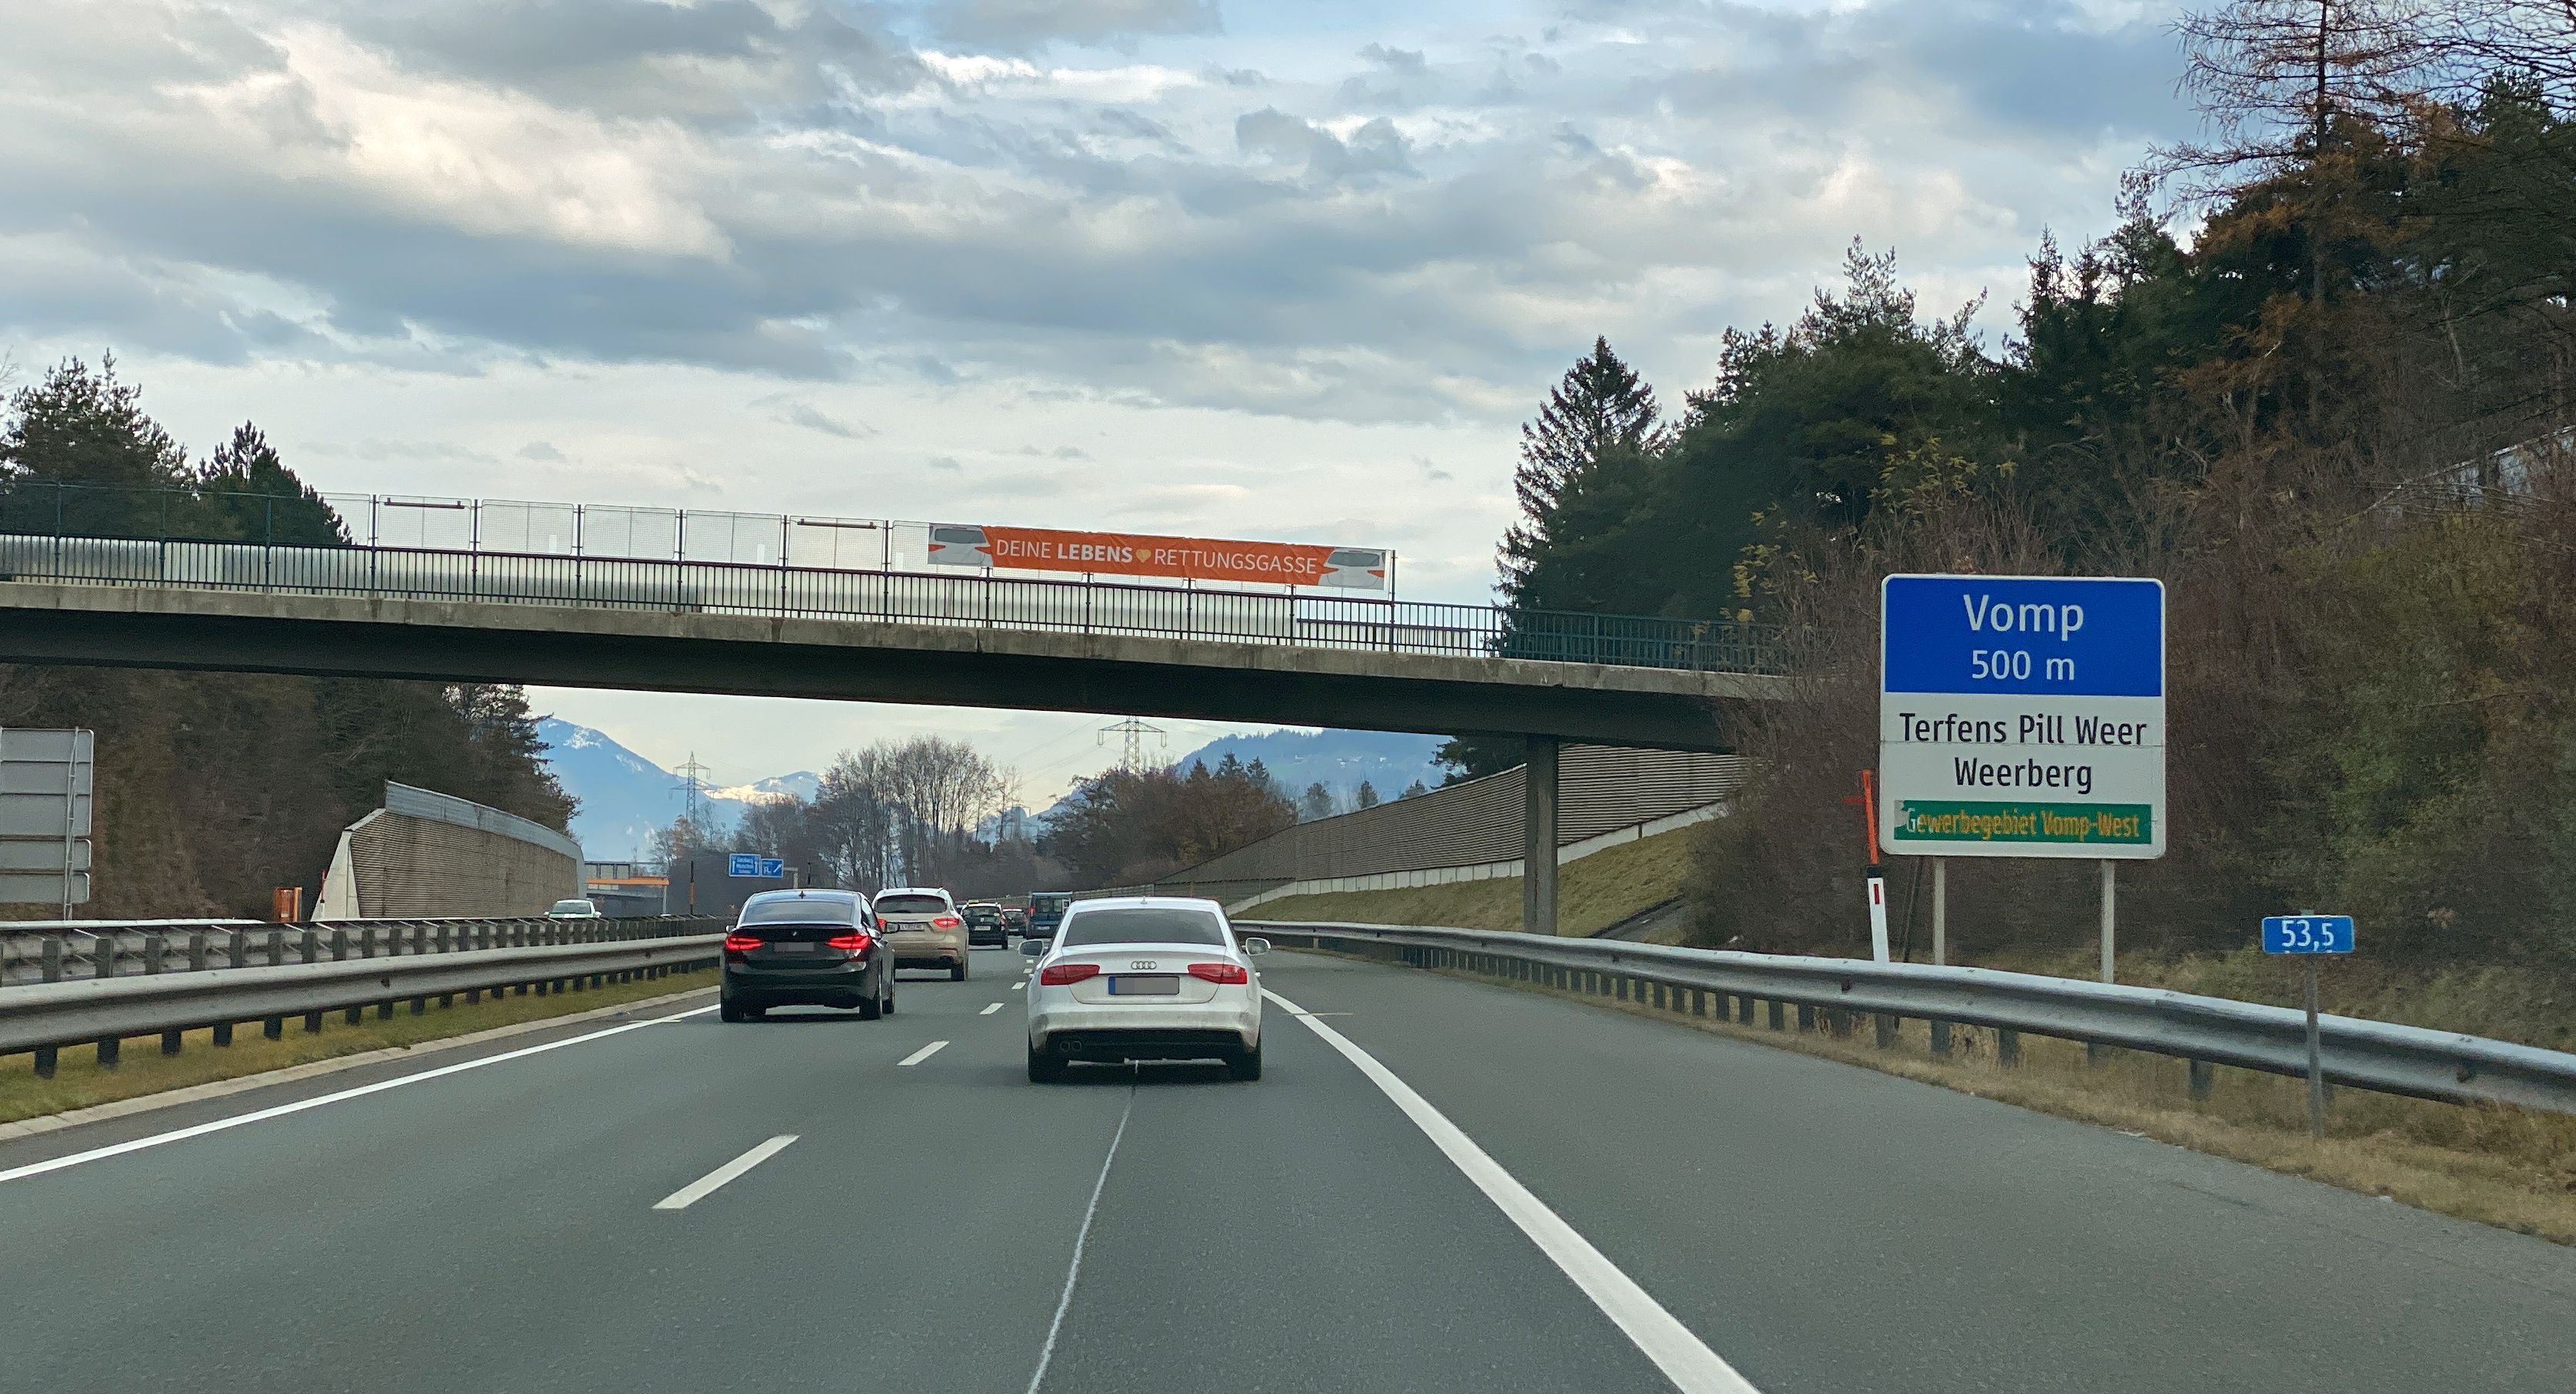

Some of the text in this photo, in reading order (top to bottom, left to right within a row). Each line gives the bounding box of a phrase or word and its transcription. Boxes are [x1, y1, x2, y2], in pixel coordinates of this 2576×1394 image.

[996, 539, 1318, 575] DEINE LEBENS RETTUNGSGASSE
[1963, 593, 2084, 642] Vomp
[1971, 649, 2075, 680] 500 m
[1899, 712, 2147, 745] Terfens Pill Weer
[1954, 756, 2092, 795] Weerberg
[1906, 807, 2139, 842] Gewerbegebiet Vomp-West
[2281, 918, 2334, 952] 53,5
